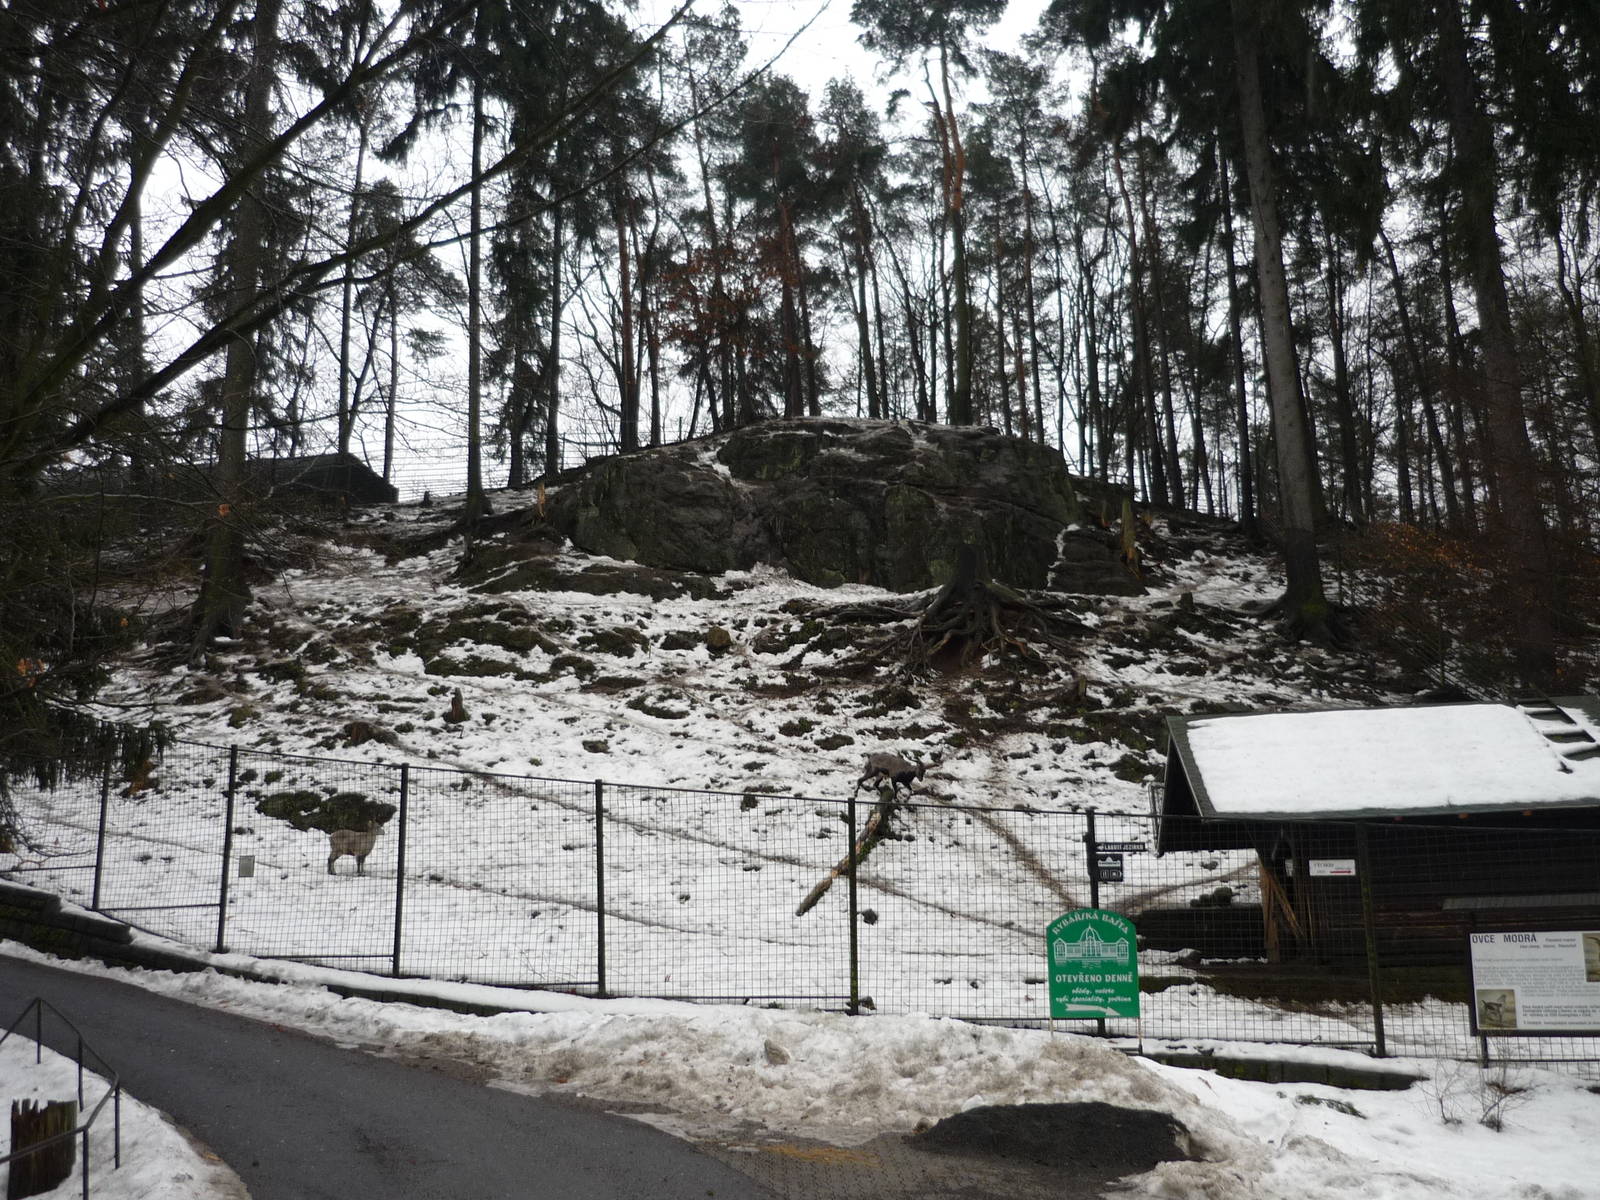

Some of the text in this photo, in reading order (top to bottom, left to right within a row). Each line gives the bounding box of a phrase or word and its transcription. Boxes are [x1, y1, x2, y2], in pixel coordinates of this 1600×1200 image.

[1052, 911, 1129, 935] RYBÁŘSKÁ BAŠTA
[1472, 934, 1496, 943] OVCE
[1055, 971, 1133, 983] OTEVŘENO DENNĚ
